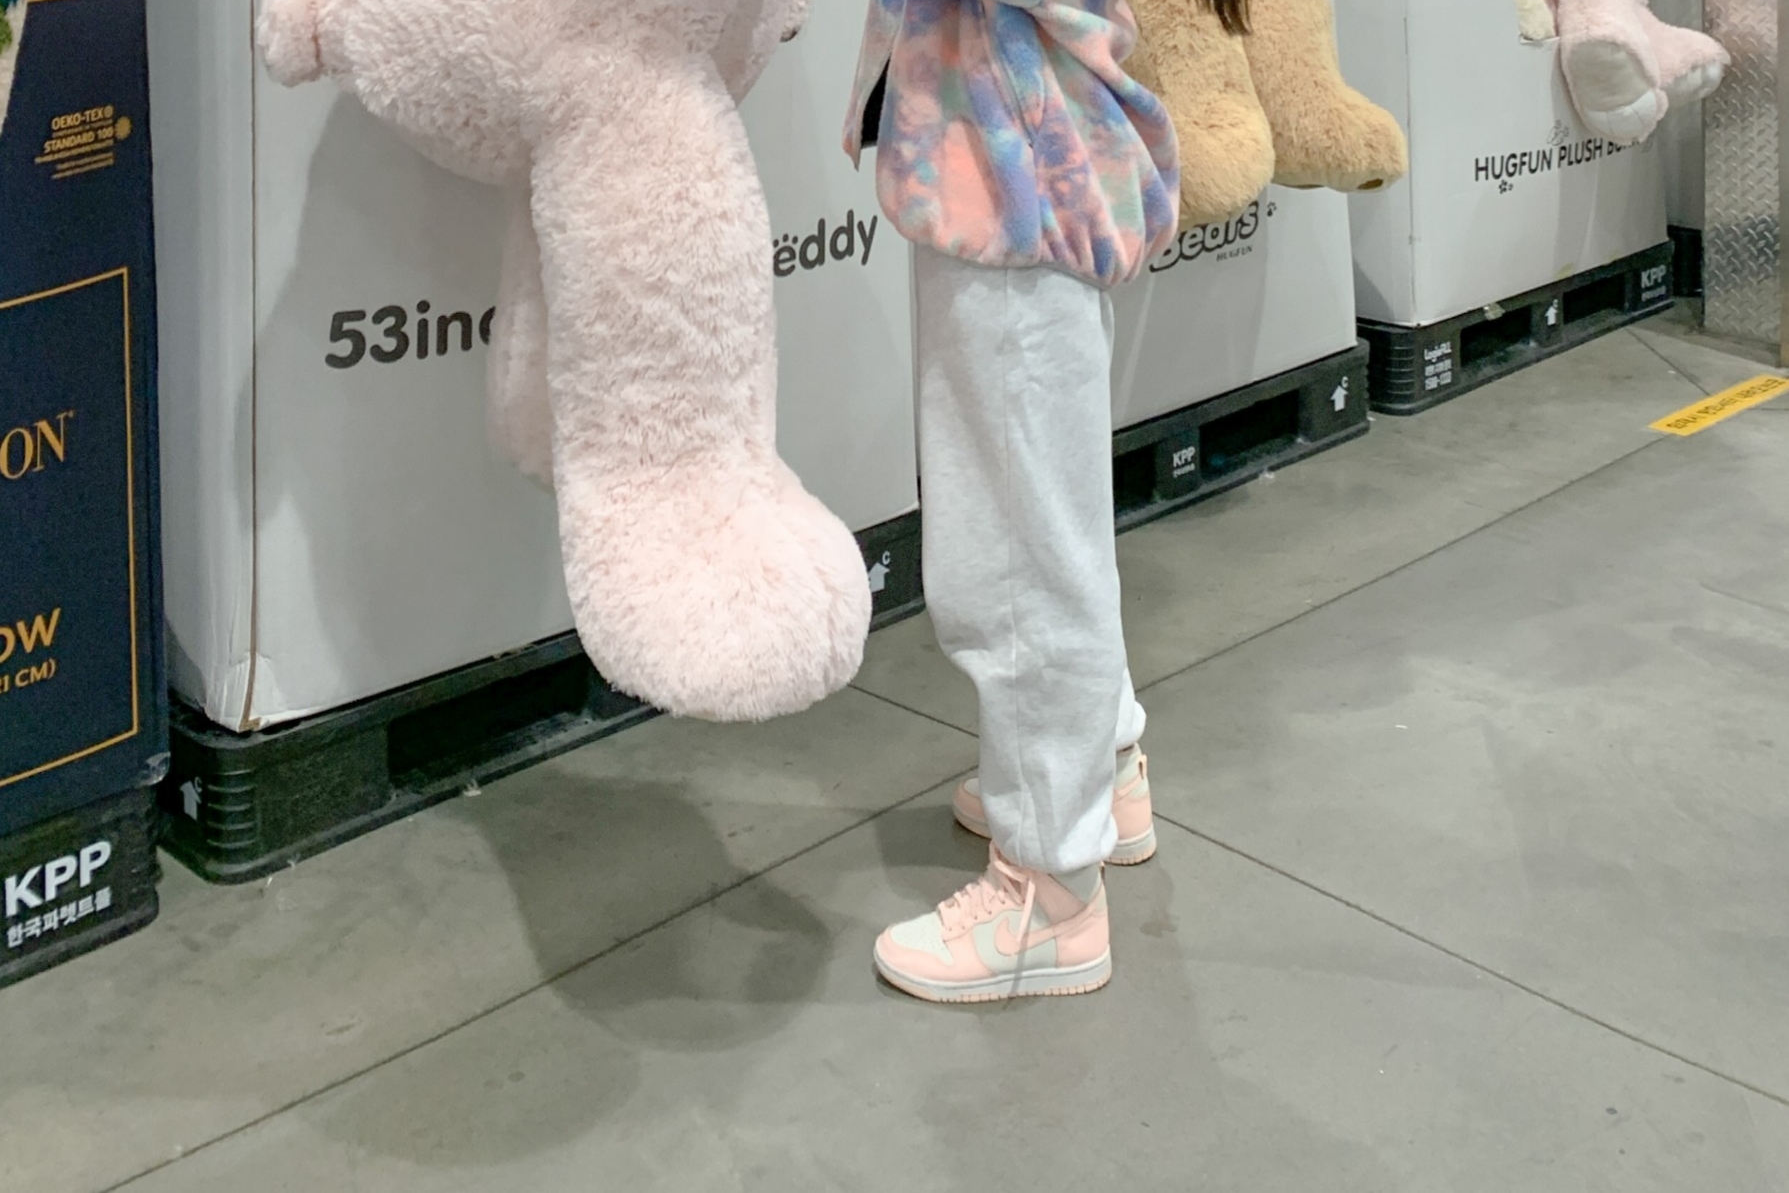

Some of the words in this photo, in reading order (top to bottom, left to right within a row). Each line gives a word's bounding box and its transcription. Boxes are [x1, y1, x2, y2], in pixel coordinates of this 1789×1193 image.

[43, 131, 95, 153] STANDARD
[97, 126, 114, 141] 100
[1474, 147, 1554, 182] HUGFUN
[1557, 137, 1604, 169] PLUSH
[1641, 264, 1667, 289] KPP
[1172, 446, 1196, 468] KPP
[15, 658, 56, 688] CM)
[4, 840, 112, 918] KPP
